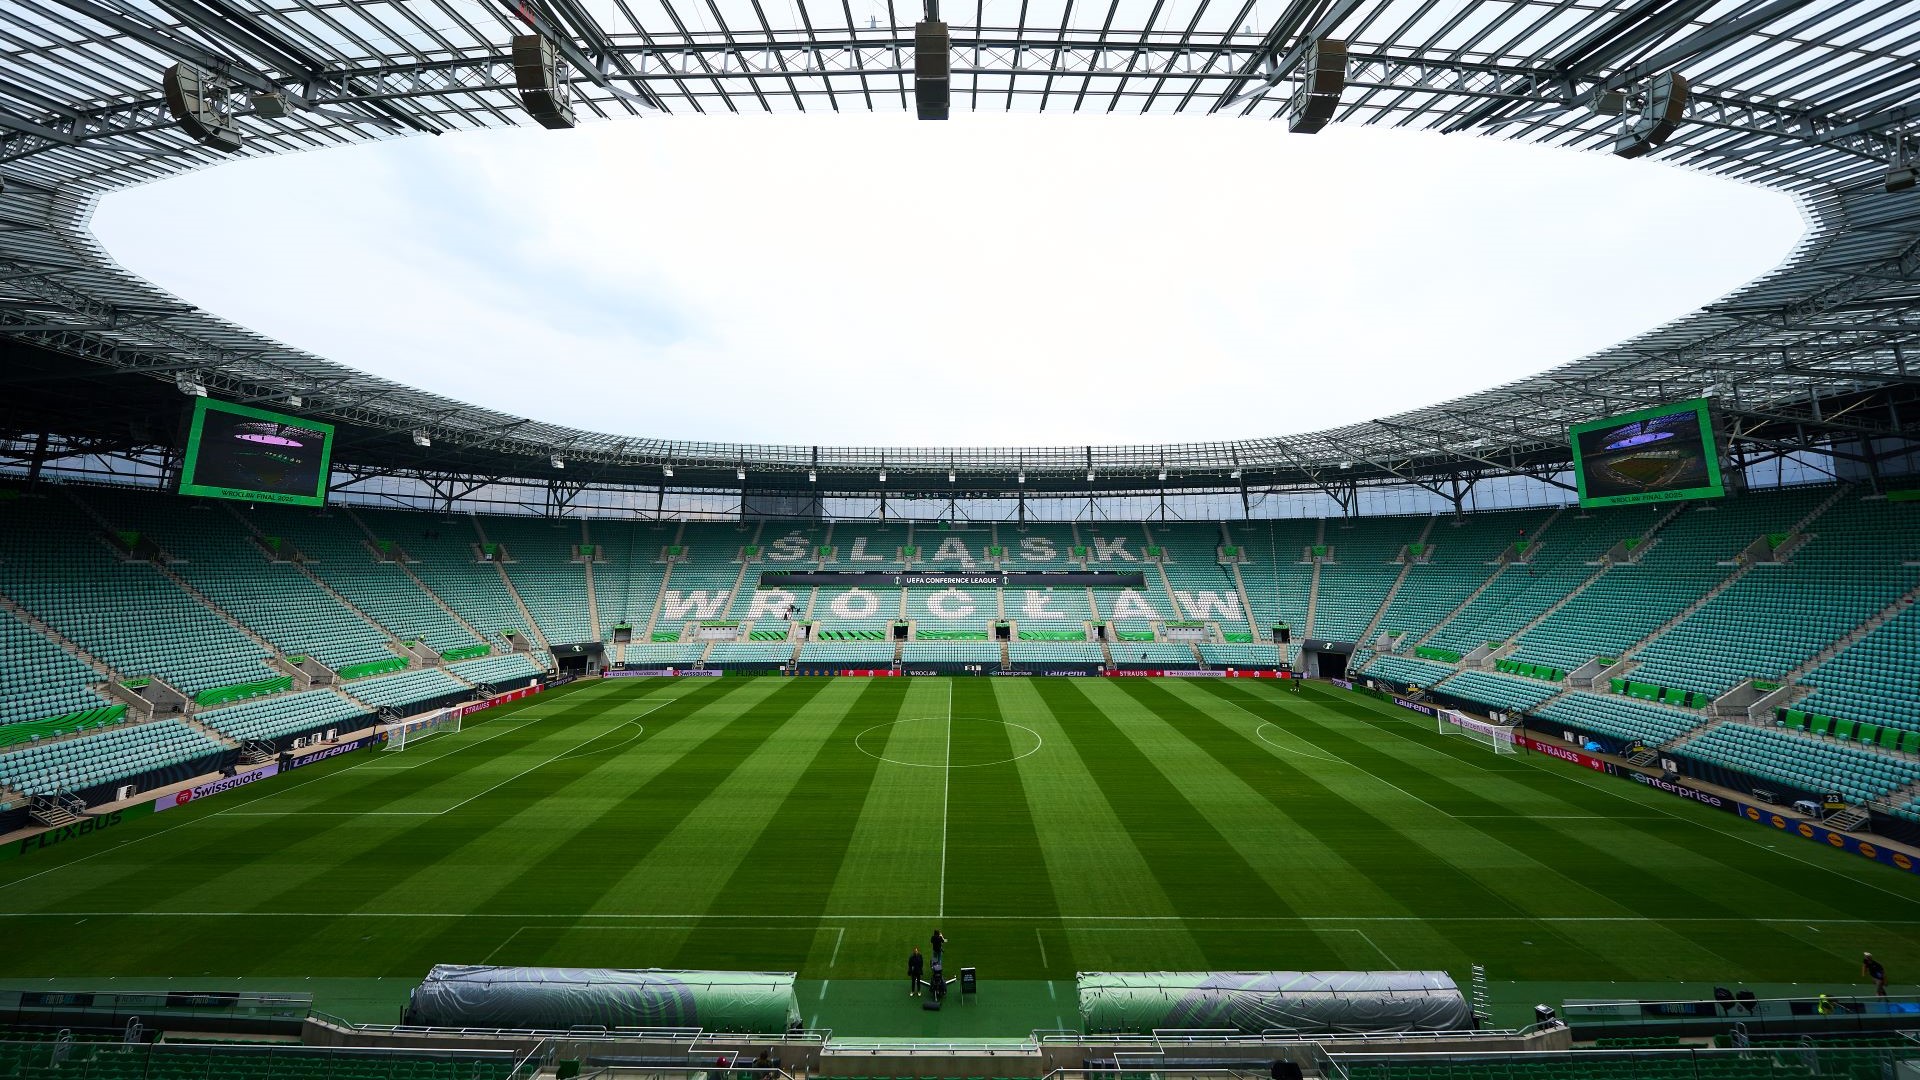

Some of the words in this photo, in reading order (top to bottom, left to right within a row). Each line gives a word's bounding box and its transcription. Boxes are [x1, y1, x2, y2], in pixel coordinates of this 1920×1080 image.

[464, 702, 490, 715] STRAUSS
[1536, 742, 1579, 763] STRAUSS
[193, 770, 263, 799] Swissquote
[1634, 771, 1722, 807] enterprise
[1826, 794, 1839, 803] 23
